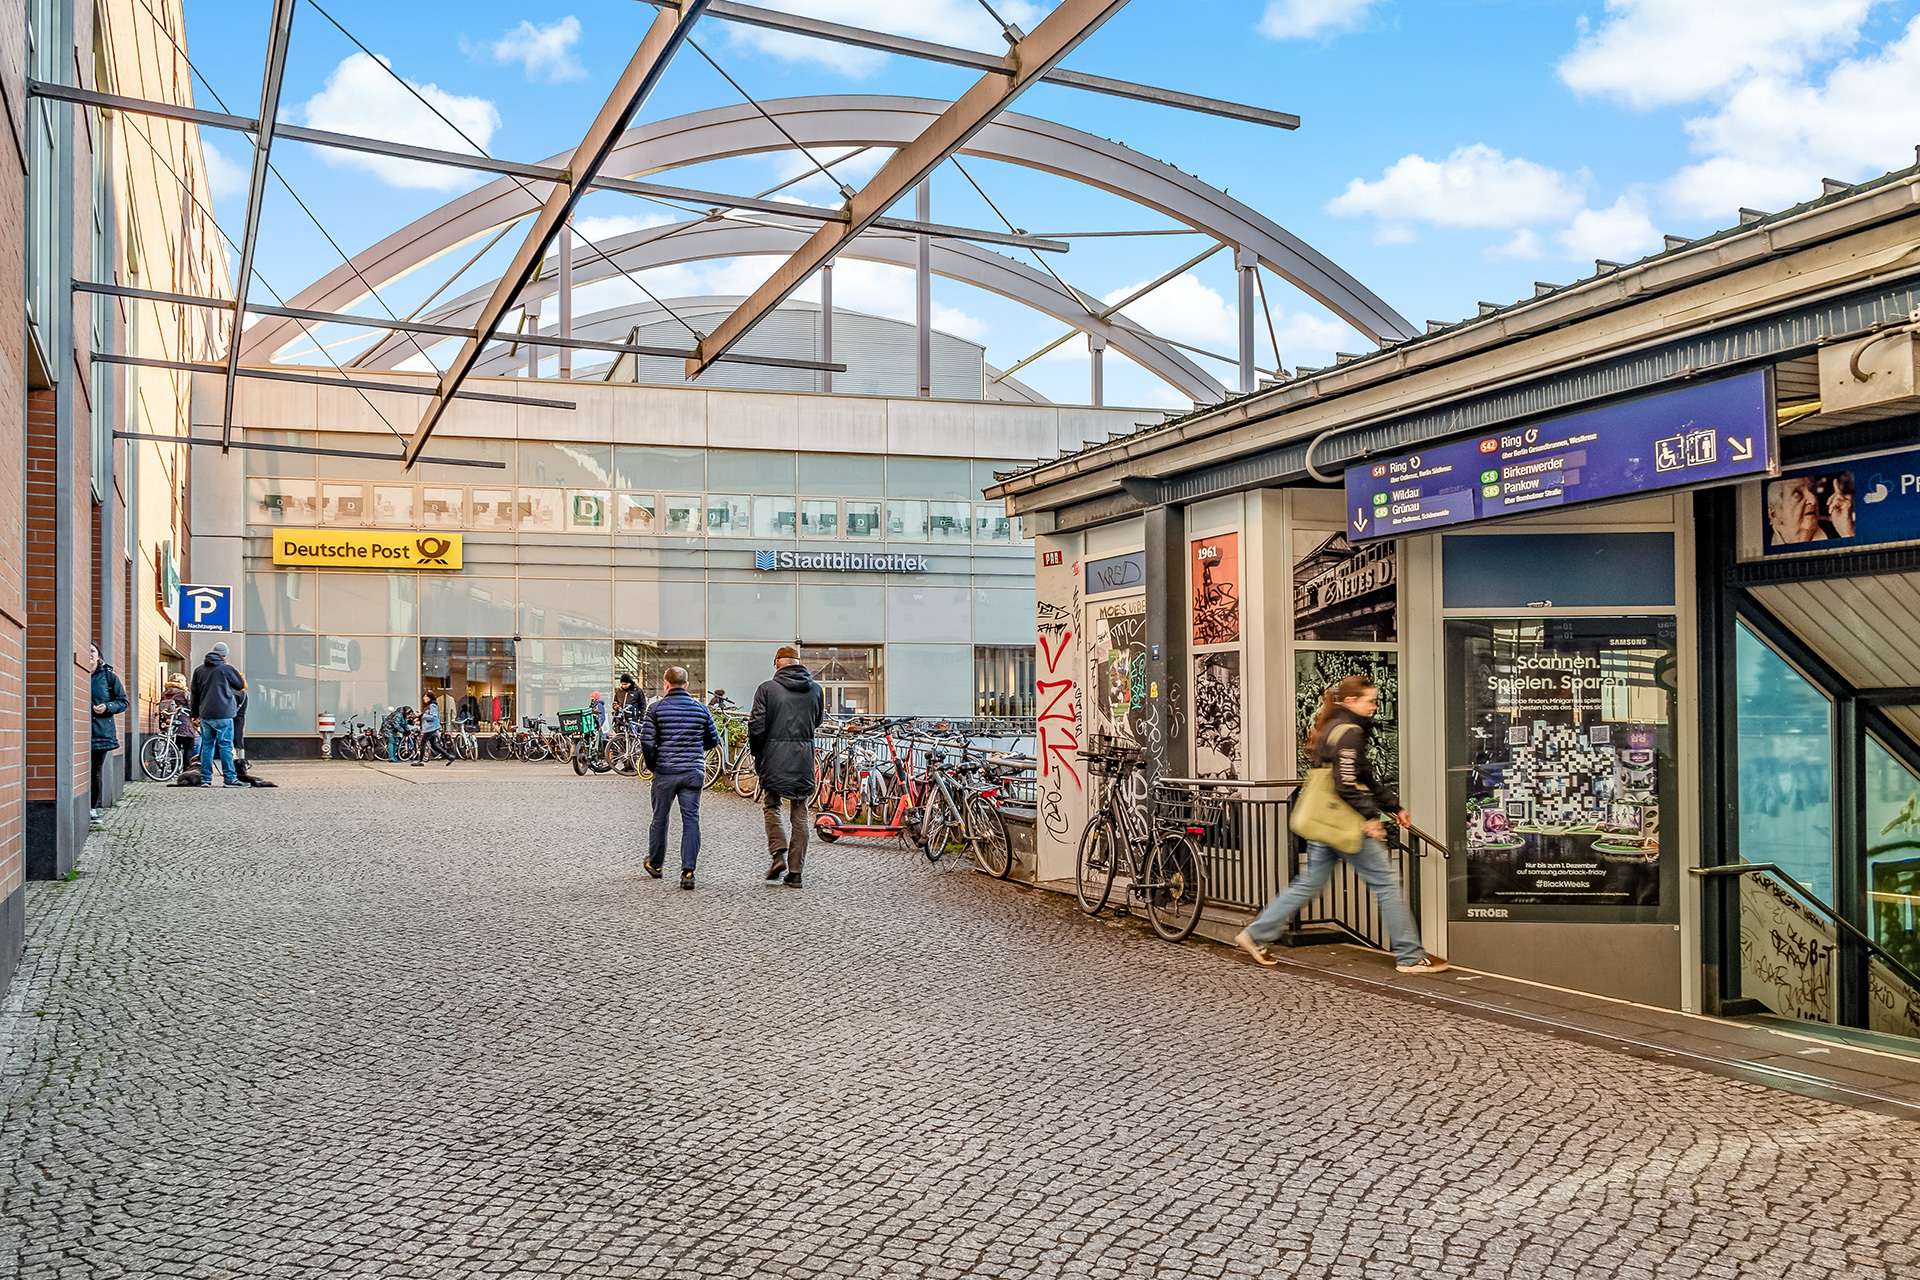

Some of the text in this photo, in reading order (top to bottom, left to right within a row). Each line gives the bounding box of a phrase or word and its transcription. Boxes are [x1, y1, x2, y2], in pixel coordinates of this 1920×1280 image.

[1480, 435, 1522, 451] S42 Ring
[1390, 460, 1408, 474] Ring
[1483, 458, 1564, 483] S8 Birkenwerder
[1504, 479, 1540, 494] Pankow
[1392, 488, 1420, 502] Wildau
[1392, 502, 1420, 515] Grünau
[284, 541, 410, 559] Deutsche Post
[1197, 545, 1217, 560] 1961
[780, 551, 929, 571] Stadtbibliothek
[1336, 568, 1374, 600] NEUES
[195, 595, 217, 623] P
[187, 623, 223, 631] Nachtzugang
[1609, 638, 1647, 647] SAMSUNG
[1517, 655, 1600, 671] Scannen.
[1487, 674, 1557, 693] Spielen.
[1535, 879, 1591, 889] #BlackWeeks
[1467, 906, 1509, 919] STRÖER
